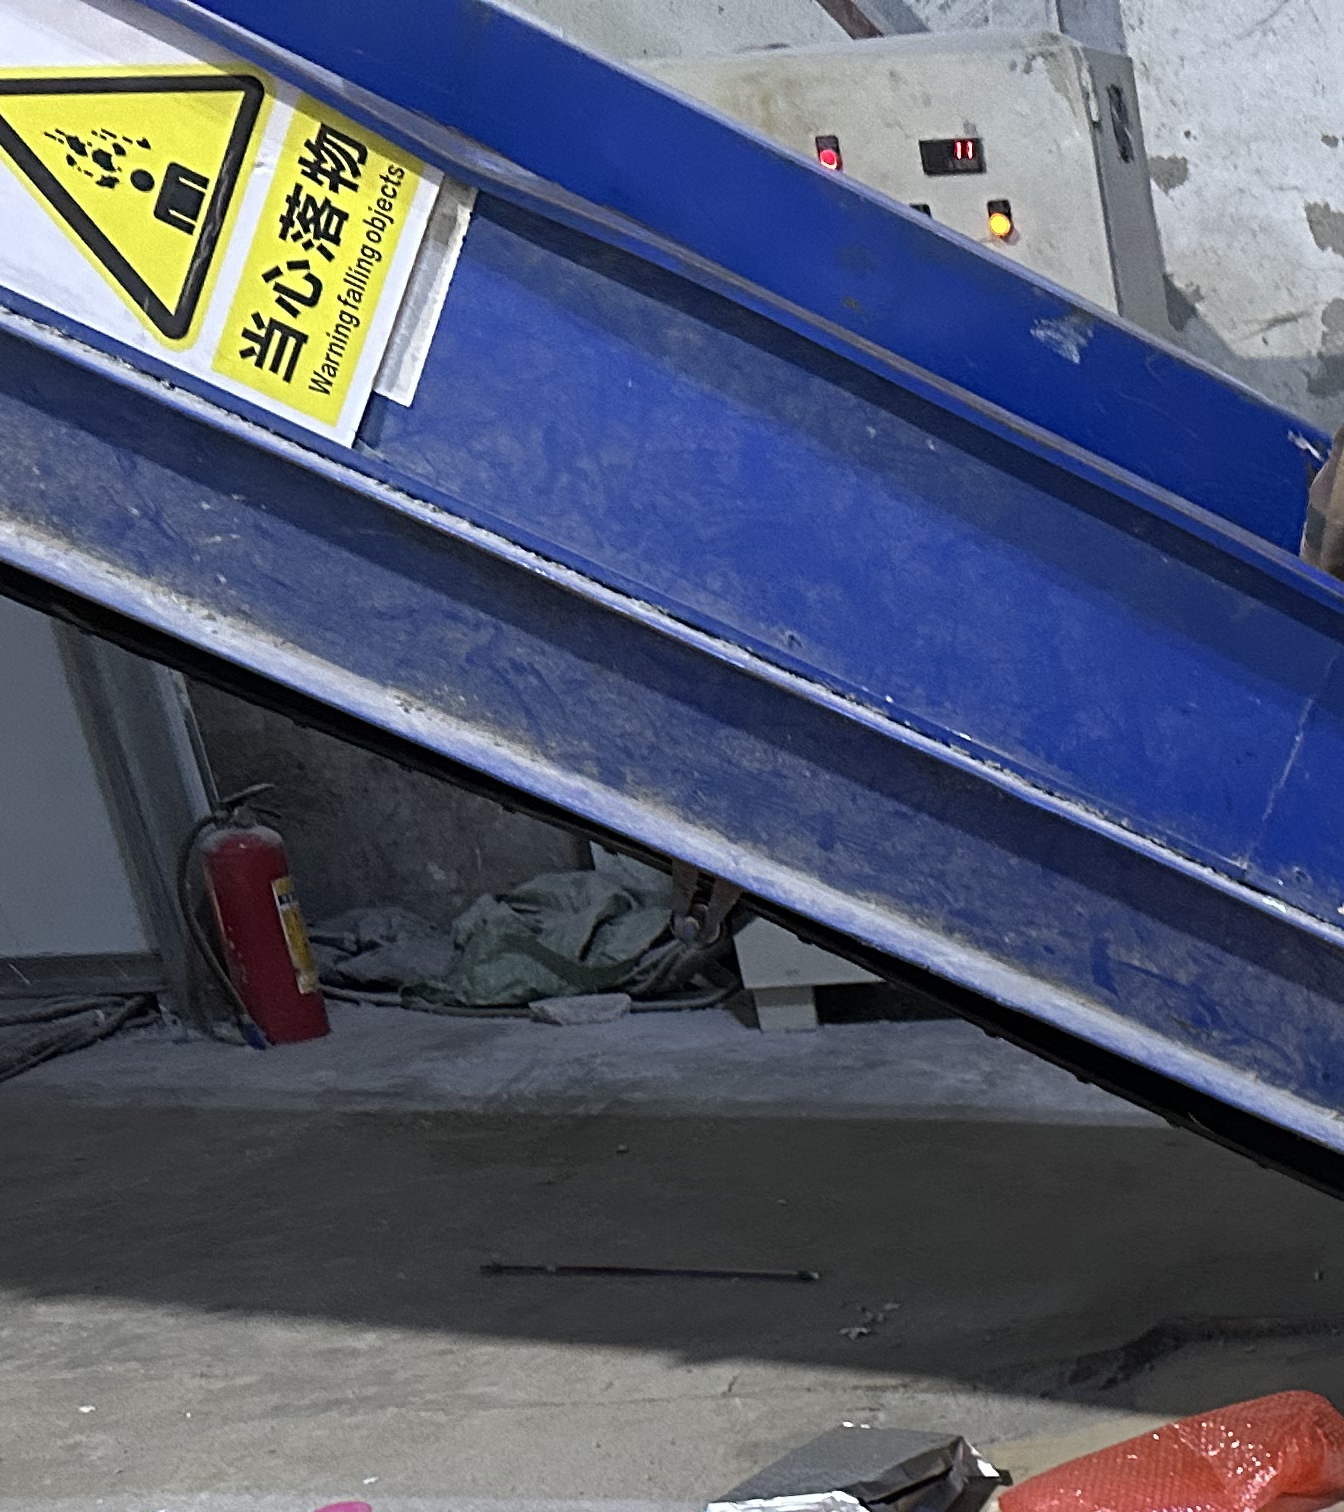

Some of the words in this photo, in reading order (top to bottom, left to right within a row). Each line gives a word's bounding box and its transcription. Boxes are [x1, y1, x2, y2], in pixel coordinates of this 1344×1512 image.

[239, 122, 368, 384] 当心落物
[308, 311, 361, 396] Warning
[336, 244, 382, 313] falling
[362, 163, 405, 244] objects
